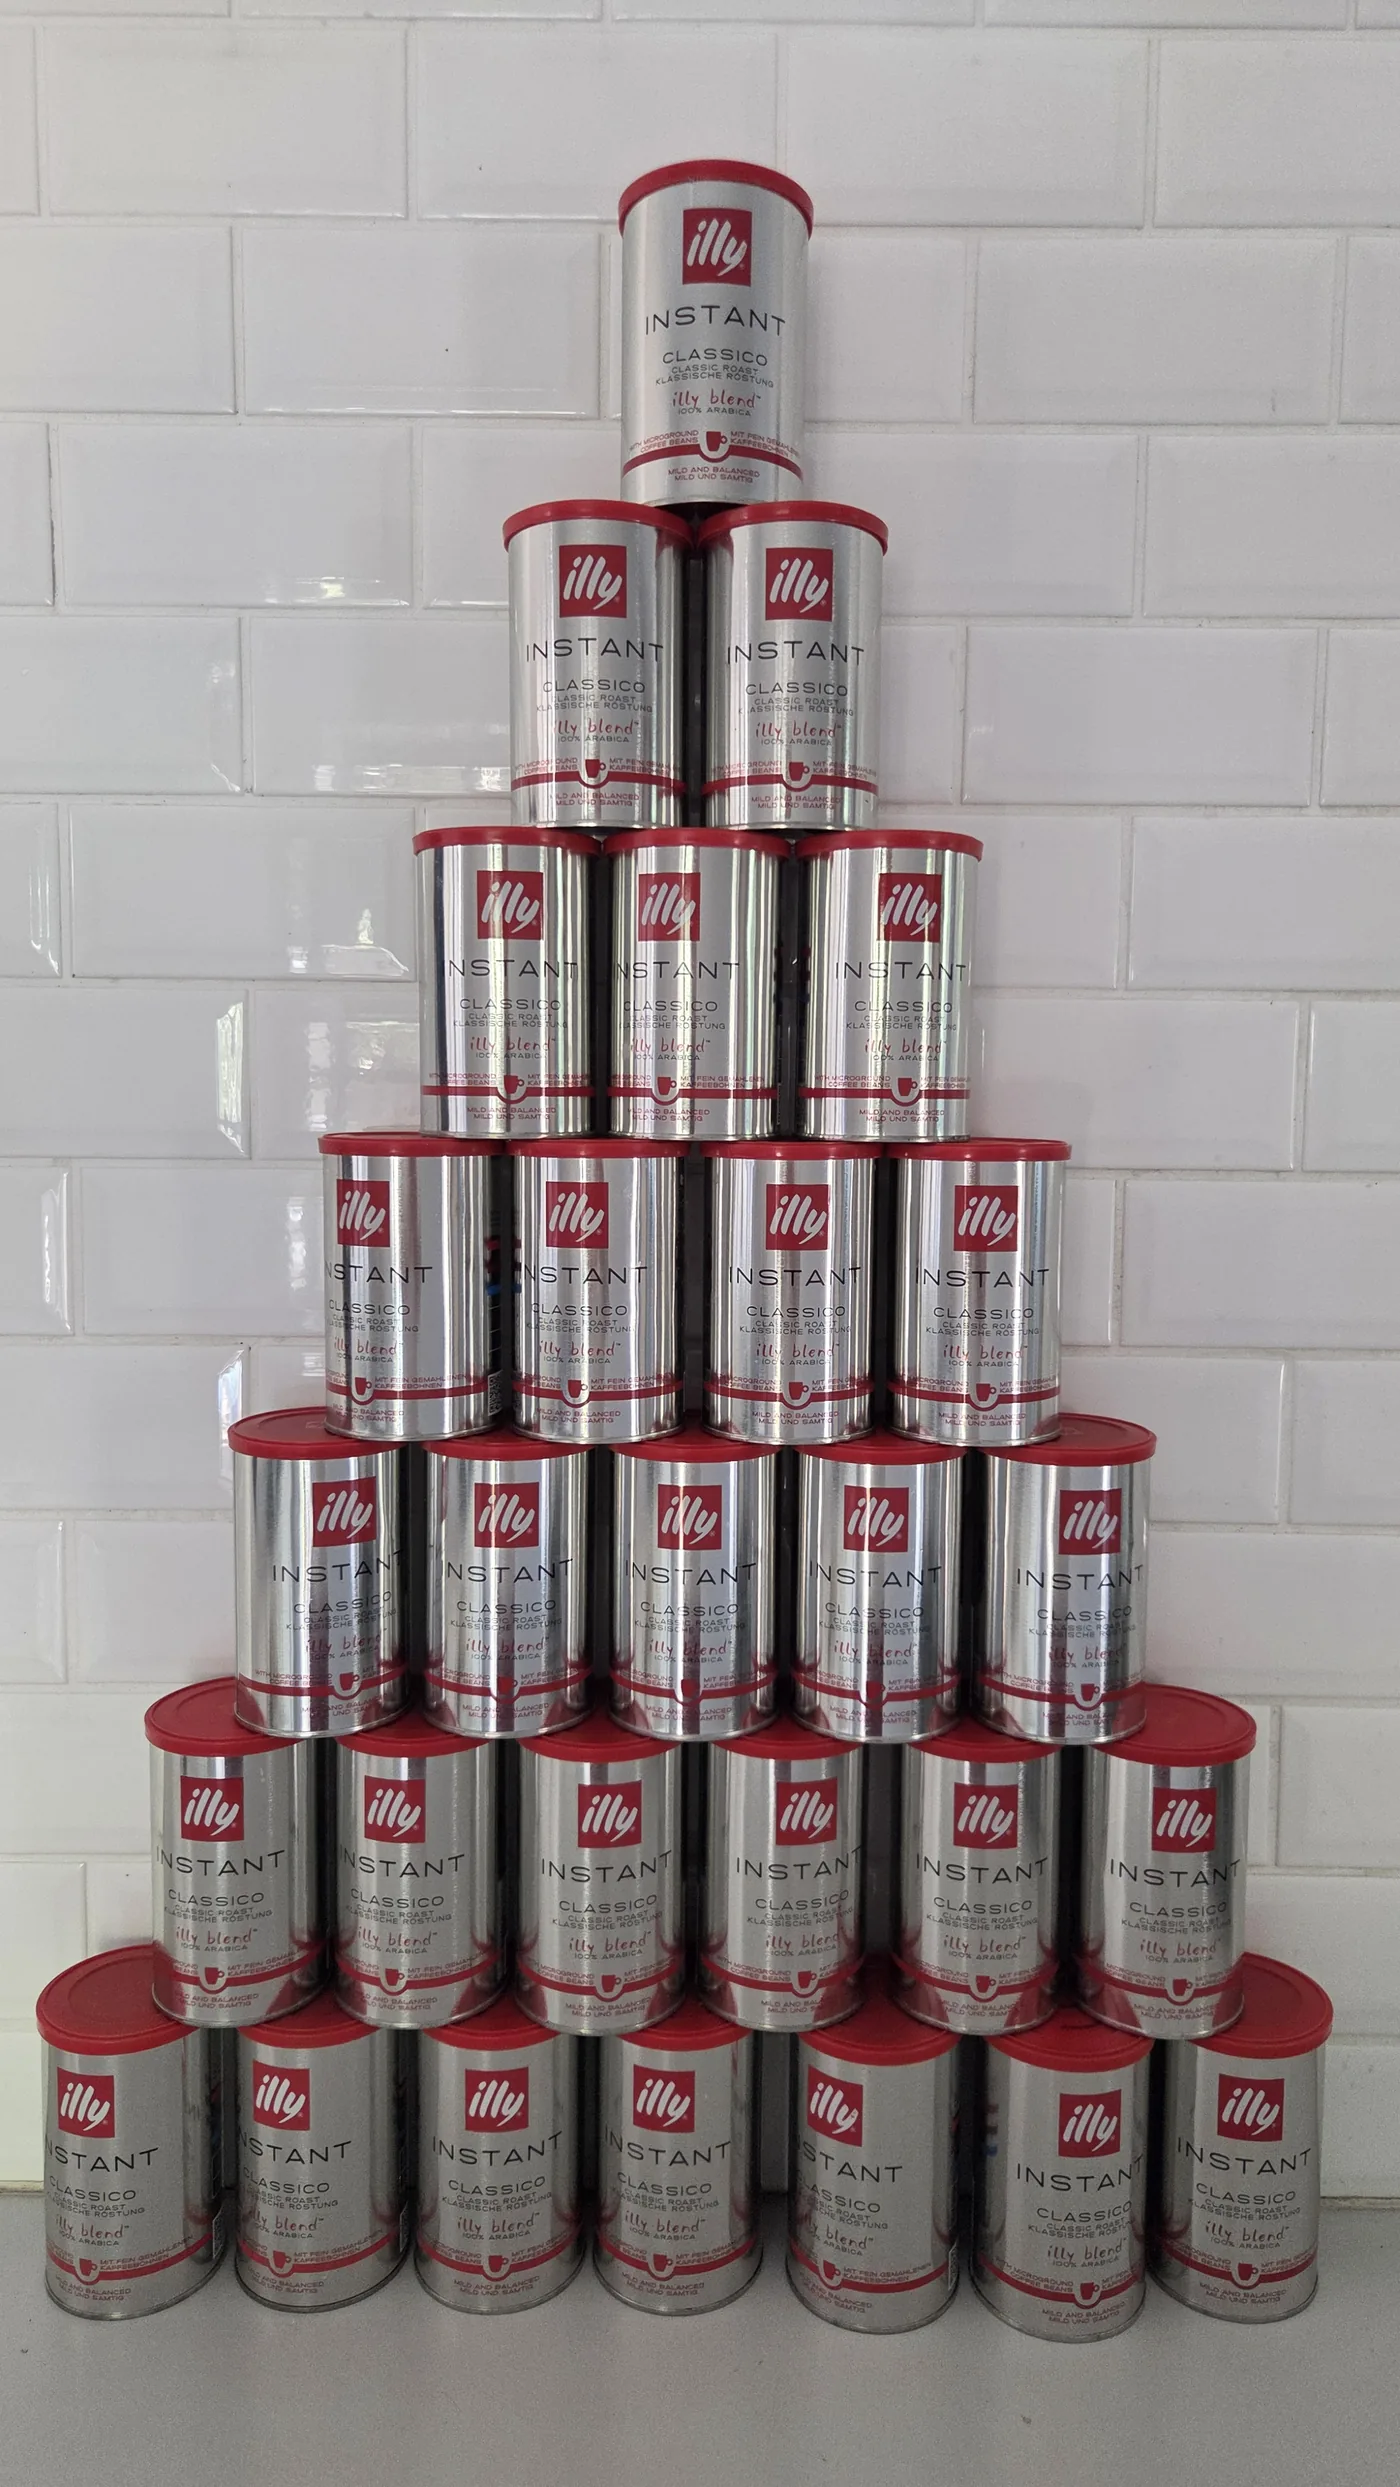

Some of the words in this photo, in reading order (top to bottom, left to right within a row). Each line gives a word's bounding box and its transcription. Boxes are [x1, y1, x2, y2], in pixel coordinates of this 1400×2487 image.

[687, 218, 747, 276] illy
[646, 305, 786, 336] INSTANT
[662, 348, 768, 367] CLASSICO
[655, 371, 723, 386] KLASSISCHE
[672, 364, 719, 374] CLASSIC
[723, 364, 758, 376] ROAST
[673, 392, 698, 407] illy
[706, 407, 752, 416] ARABICA
[669, 436, 698, 445] BEANS
[668, 467, 690, 477] MILD
[712, 467, 760, 478] BALANCED
[675, 473, 696, 481] MILD
[563, 555, 622, 610] illy
[770, 558, 829, 613] illy
[527, 638, 663, 662] INSTANT
[728, 641, 864, 665] INSTANT
[543, 679, 645, 693] CLASSICO
[745, 682, 848, 696] CLASSICO
[601, 694, 636, 702] ROAST
[805, 698, 839, 707] ROAST
[756, 722, 782, 738] illy
[481, 881, 540, 933] illy
[642, 882, 696, 935] illy
[881, 883, 937, 935] illy
[449, 960, 578, 979] NSTANT
[618, 962, 740, 980] NSTANT
[836, 962, 966, 980] INSTANT
[460, 999, 561, 1010] CLASSICO
[624, 1000, 717, 1011] CLASSICO
[854, 1001, 953, 1012] CLASSICO
[470, 1036, 496, 1051] illy
[339, 1190, 386, 1240] illy
[549, 1192, 604, 1241] illy
[770, 1194, 826, 1244] illy
[958, 1195, 1015, 1246] illy
[325, 1266, 432, 1284] NSTANT
[524, 1266, 647, 1284] NSTANT
[730, 1267, 861, 1286] INSTANT
[916, 1268, 1049, 1287] INSTANT
[329, 1303, 410, 1315] CLASSICO
[532, 1304, 627, 1315] CLASSICO
[747, 1306, 845, 1318] CLASSICO
[933, 1308, 1033, 1319] CLASSICO
[540, 1342, 561, 1357] illy
[756, 1344, 782, 1358] illy
[944, 1346, 969, 1360] illy
[317, 1491, 373, 1539] illy
[477, 1493, 535, 1542] illy
[662, 1495, 718, 1544] illy
[847, 1497, 904, 1547] illy
[1063, 1500, 1118, 1548] illy
[273, 1551, 400, 1583] INSTANT
[447, 1558, 573, 1583] NSTANT
[625, 1560, 757, 1586] INSTANT
[810, 1561, 942, 1587] INSTANT
[1017, 1565, 1143, 1590] INSTANT
[293, 1591, 391, 1614] CLASSICO
[457, 1600, 556, 1615] CLASSICO
[641, 1602, 739, 1615] CLASSICO
[826, 1603, 924, 1618] CLASSICO
[1037, 1605, 1131, 1621] CLASSCO
[465, 1637, 490, 1654] illy
[184, 1788, 239, 1836] illy
[368, 1788, 421, 1837] illy
[582, 1793, 638, 1842] illy
[780, 1790, 834, 1838] illy
[958, 1795, 1013, 1843] illy
[1156, 1799, 1212, 1847] illy
[156, 1846, 285, 1877] INSTANT
[340, 1844, 465, 1878] INSTANT
[542, 1850, 672, 1883] INSTANT
[736, 1846, 862, 1880] INSTANT
[917, 1853, 1048, 1883] INSTANT
[1110, 1858, 1240, 1887] INSTANT
[168, 1889, 264, 1906] CLASSICO
[351, 1889, 444, 1908] CLASSICO
[559, 1894, 656, 1913] CLASSICO
[756, 1890, 848, 1910] CLASSICO
[934, 1897, 1032, 1914] CLASSICO
[219, 1908, 253, 1916] ROAST
[568, 1914, 612, 1923] CLASSIC
[616, 1910, 649, 1922] ROAST
[1130, 1901, 1227, 1917] CLASSICO
[176, 1927, 198, 1944] illy
[358, 1928, 379, 1946] illy
[569, 1938, 594, 1953] illy
[944, 1935, 968, 1951] illy
[601, 1950, 643, 1959] ARABICA
[60, 2082, 111, 2131] illy
[256, 2075, 305, 2124] illy
[469, 2080, 524, 2127] illy
[637, 2079, 690, 2127] illy
[810, 2082, 858, 2134] illy
[1222, 2088, 1279, 2135] illy
[1063, 2104, 1117, 2151] illy
[45, 2141, 158, 2172] NSTANT
[239, 2132, 351, 2164] NSTANT
[433, 2131, 562, 2166] INSTANT
[605, 2125, 731, 2166] INSTANT
[1178, 2137, 1311, 2175] INSTANT
[803, 2141, 903, 2183] STANT
[1017, 2154, 1143, 2191] INSTANT
[50, 2175, 136, 2201] CLASSICO
[244, 2167, 329, 2193] CLASSICO
[448, 2177, 545, 2195] CLASSICO
[617, 2172, 711, 2195] CLASSICO
[797, 2169, 880, 2213] CLASSICO
[1196, 2183, 1296, 2205] CLASSICO
[625, 2211, 646, 2231] illy
[1037, 2201, 1132, 2223] CLASSICO
[55, 2216, 75, 2238] illy
[458, 2217, 481, 2234] illy
[1205, 2221, 1231, 2241] illy
[1047, 2245, 1074, 2261] illy
